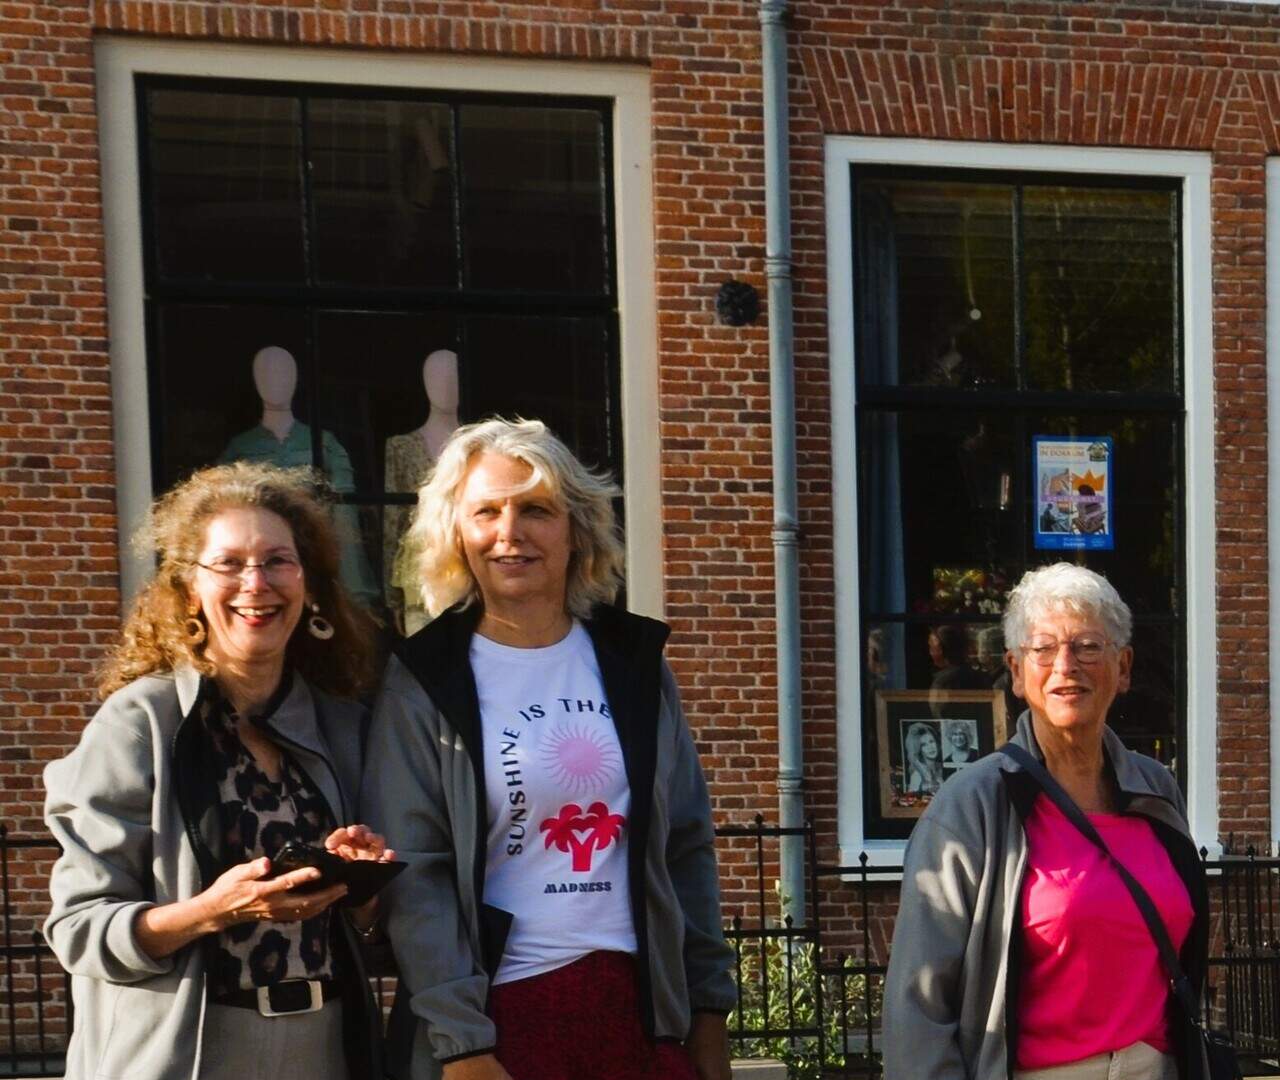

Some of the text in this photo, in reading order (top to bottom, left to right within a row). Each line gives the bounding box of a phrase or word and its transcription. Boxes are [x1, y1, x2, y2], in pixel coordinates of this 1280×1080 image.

[500, 698, 610, 857] SUNSHINE IS THE
[543, 881, 612, 894] MADNESS
